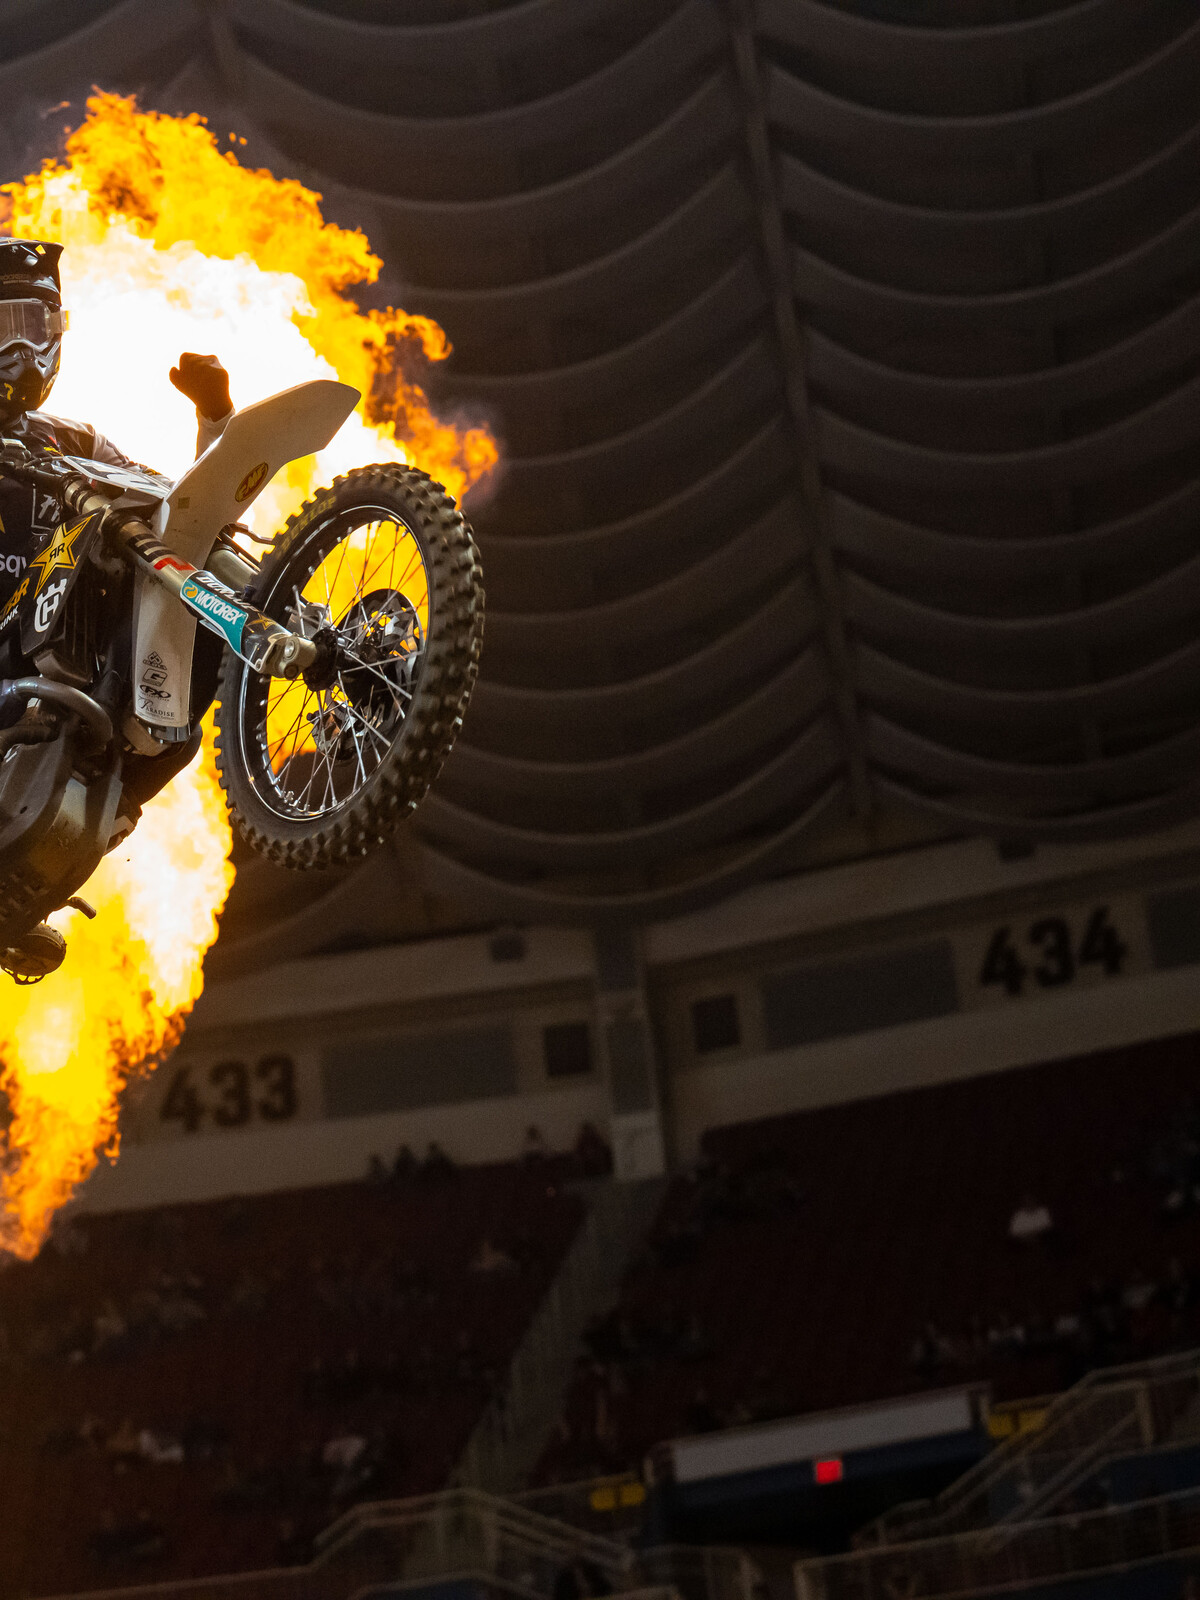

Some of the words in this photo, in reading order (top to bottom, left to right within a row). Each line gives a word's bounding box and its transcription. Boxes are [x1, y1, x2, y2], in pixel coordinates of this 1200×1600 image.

[194, 590, 243, 626] MOTOREX
[980, 905, 1126, 996] 434
[159, 1053, 298, 1135] 433
